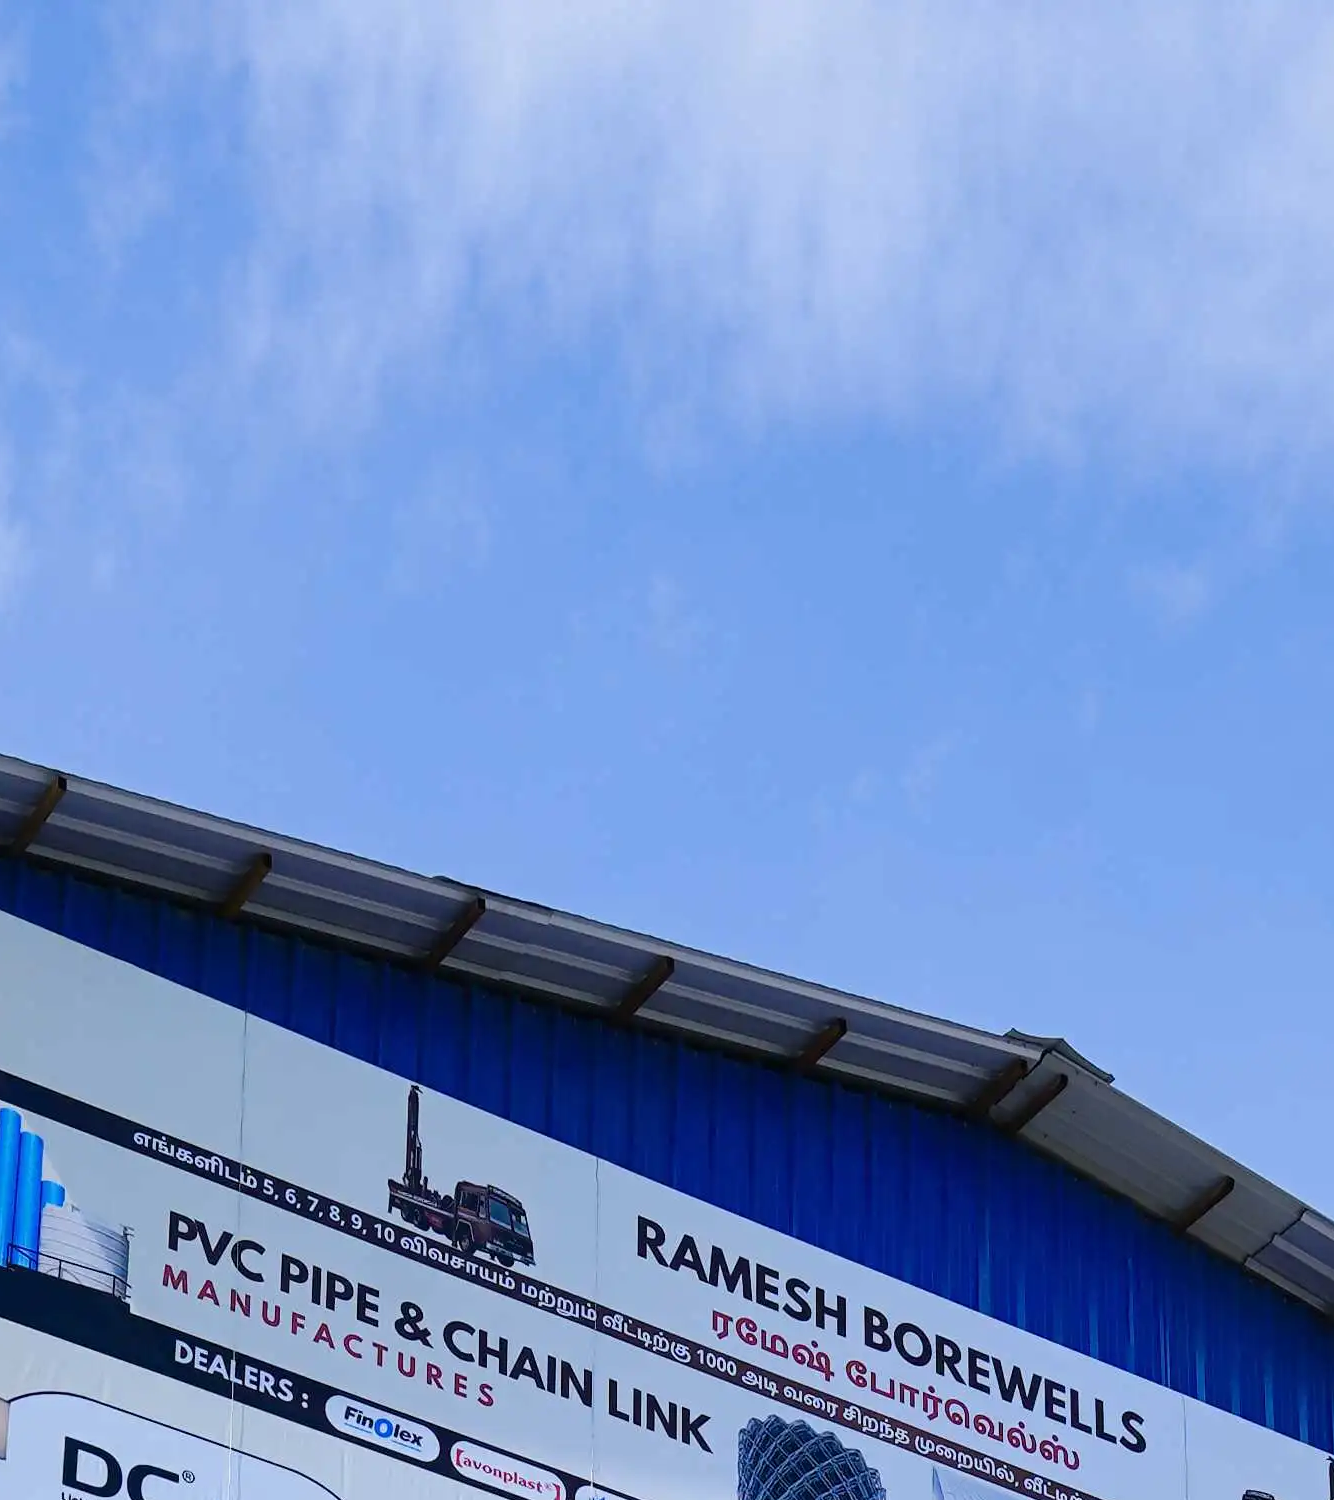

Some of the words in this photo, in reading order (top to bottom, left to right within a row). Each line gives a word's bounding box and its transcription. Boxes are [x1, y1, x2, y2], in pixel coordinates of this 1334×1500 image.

[134, 1131, 257, 1189] எங்களிடம்
[263, 1178, 279, 1200] 5,
[285, 1187, 301, 1209] 6,
[307, 1196, 323, 1218] 7,
[329, 1205, 346, 1227] 8,
[351, 1212, 367, 1234] 9,
[374, 1222, 395, 1243] 10
[400, 1236, 516, 1291] விவசாயம்
[521, 1281, 597, 1322] மற்றும்
[697, 1348, 737, 1378] 1000
[742, 1369, 779, 1397] அடி
[783, 1386, 840, 1417] வரை
[843, 1408, 910, 1445] சிறந்த
[162, 1264, 495, 1407] MANUFACTURES
[169, 1211, 266, 1283] PVC
[280, 1254, 380, 1328] PIPE
[394, 1301, 434, 1349] &
[443, 1321, 593, 1408] CHAIN
[608, 1378, 713, 1454] LINK
[175, 1340, 294, 1403] DEALERS
[637, 1215, 847, 1338] RAMESH
[864, 1305, 1147, 1453] BOREWELLS
[712, 1310, 834, 1382] ரமேஷ்
[845, 1357, 1079, 1471] போர்வெல்ஸ்
